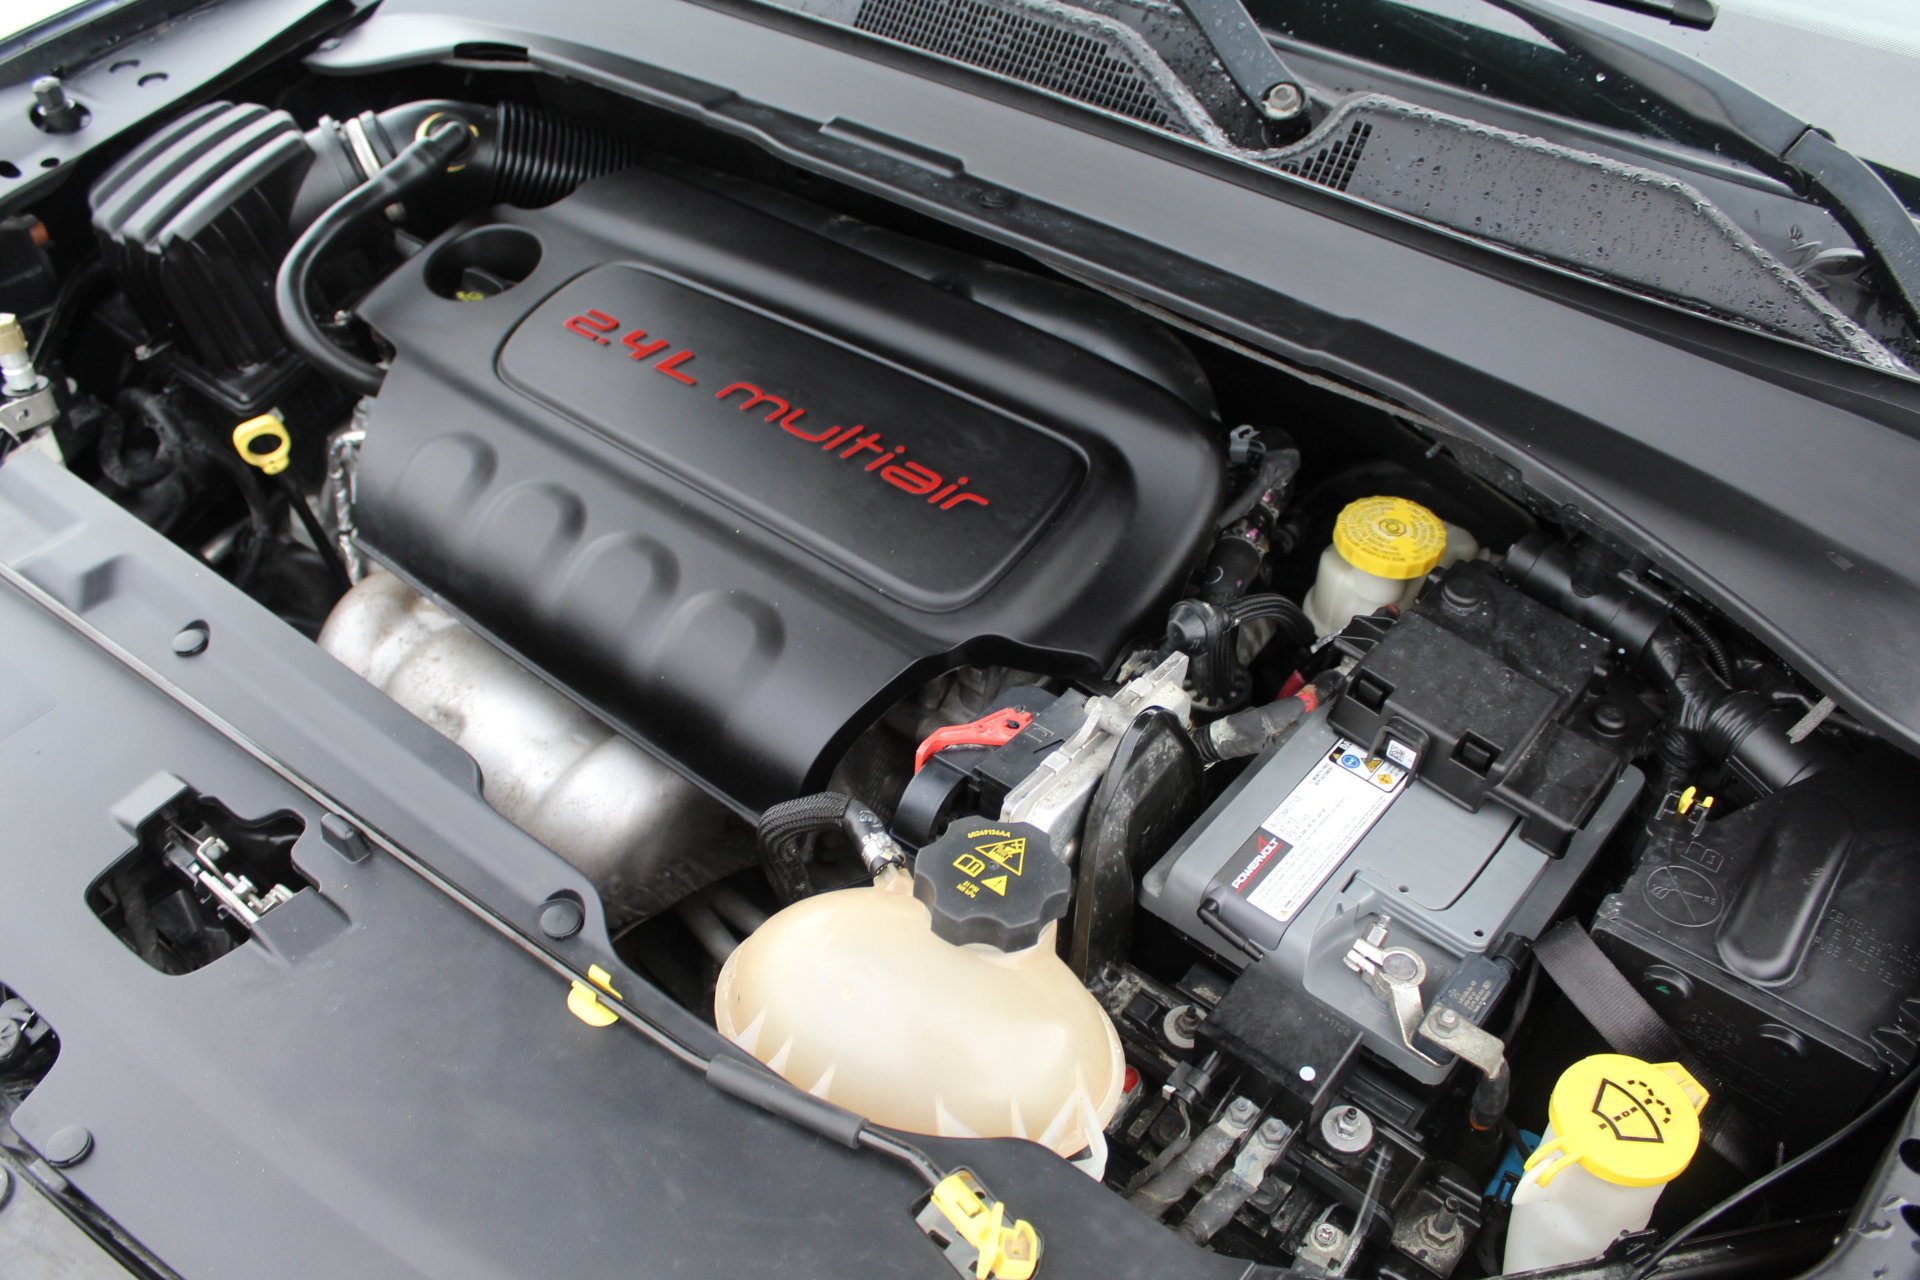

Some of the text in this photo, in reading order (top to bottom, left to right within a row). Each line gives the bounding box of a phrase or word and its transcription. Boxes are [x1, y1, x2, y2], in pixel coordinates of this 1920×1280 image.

[563, 309, 989, 510] 2.4L multiair
[1232, 838, 1280, 889] POWERVOLT
